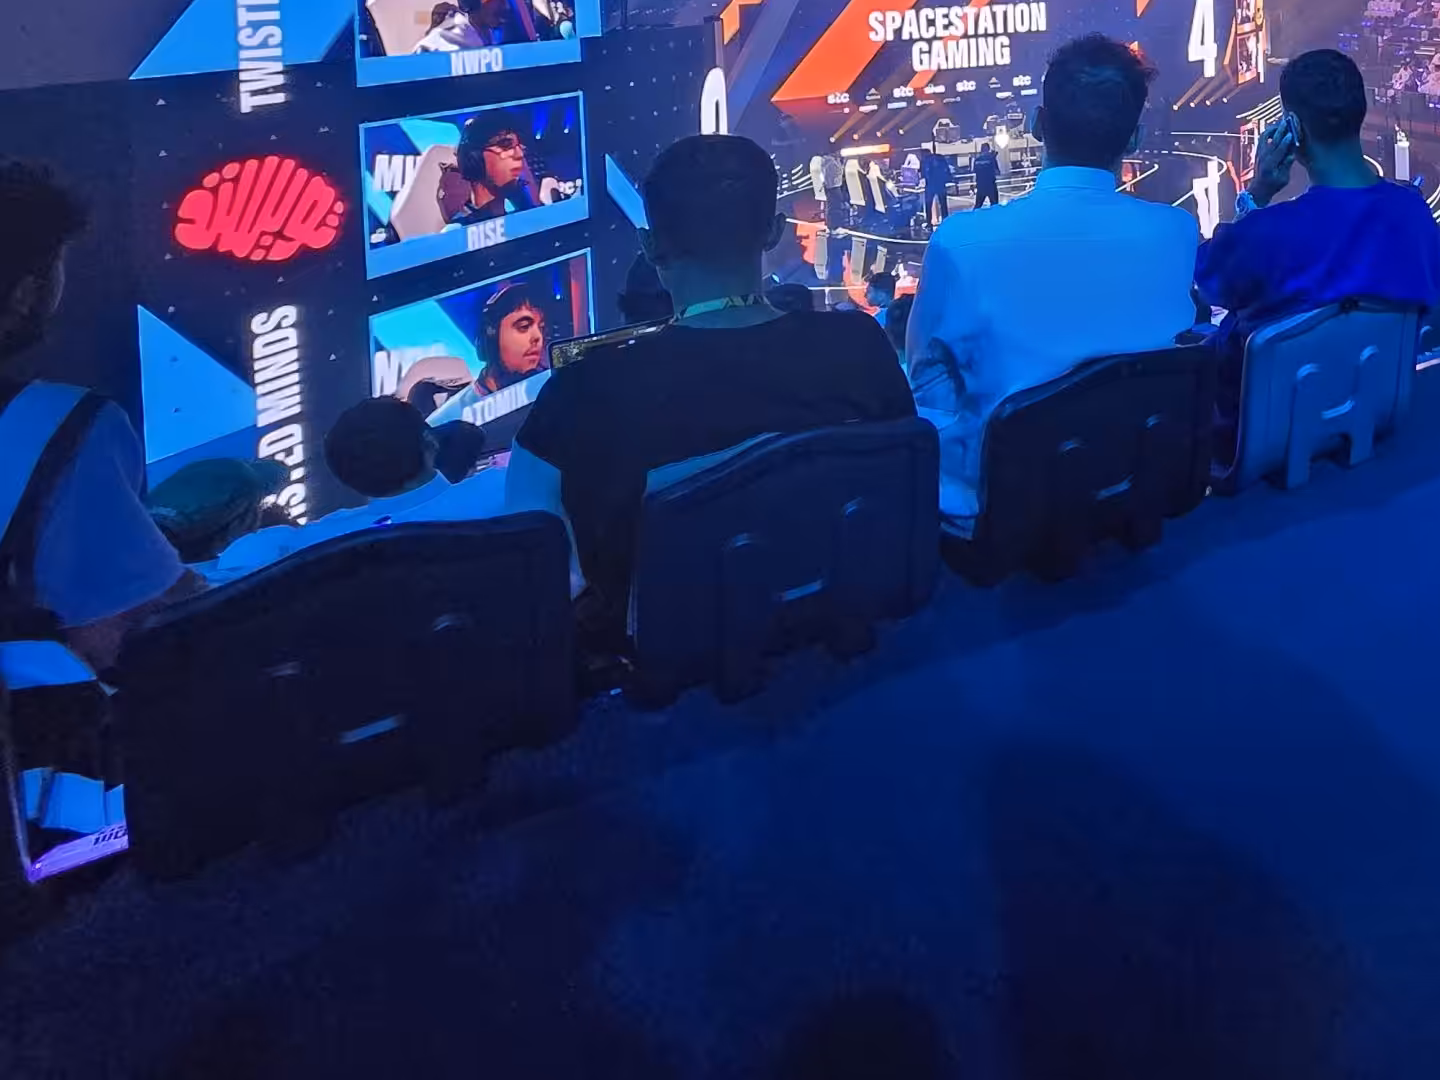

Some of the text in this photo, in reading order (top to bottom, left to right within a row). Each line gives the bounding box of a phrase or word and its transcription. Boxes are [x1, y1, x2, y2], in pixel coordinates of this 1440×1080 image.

[868, 1, 1048, 42] SPACESTATION
[449, 48, 503, 77] NWPO
[911, 35, 1012, 72] GAMING
[466, 218, 507, 250] RISE
[251, 304, 302, 428] MINDS
[462, 384, 529, 426] ATOMIK
